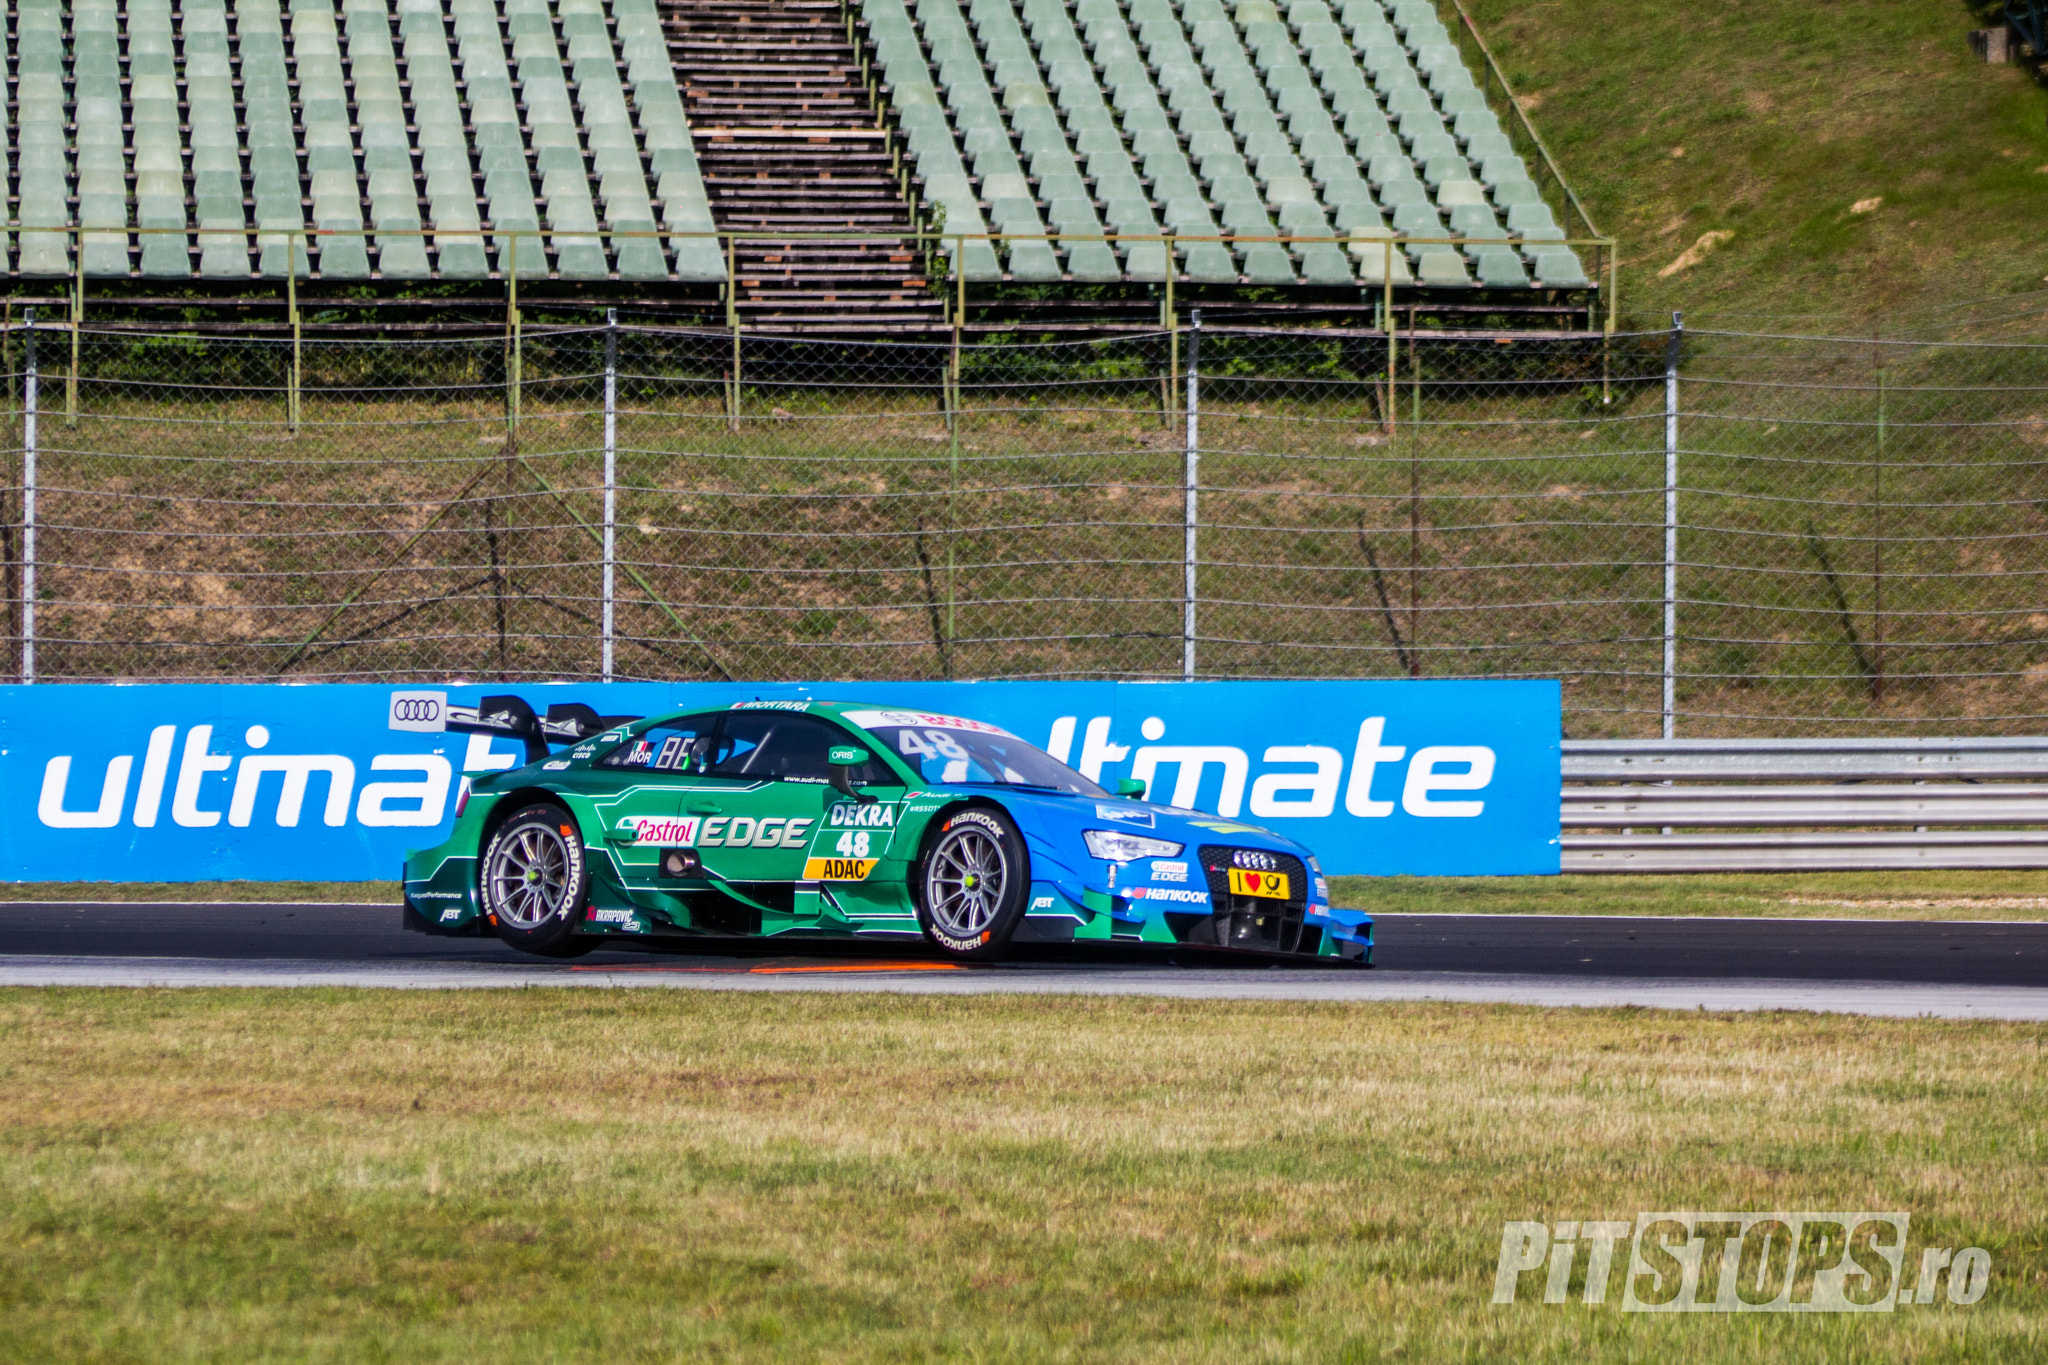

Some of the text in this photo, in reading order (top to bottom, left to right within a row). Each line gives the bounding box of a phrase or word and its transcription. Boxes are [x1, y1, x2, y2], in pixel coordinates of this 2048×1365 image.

[743, 701, 810, 712] MORTARA
[628, 752, 652, 763] MOR
[831, 752, 853, 760] ORIS
[1046, 716, 1496, 818] ltimate
[38, 725, 517, 828] ultimat
[830, 804, 893, 827] DEKRA
[637, 817, 815, 849] Castrol EDGE
[836, 831, 870, 858] 48
[823, 860, 865, 879] ADAC
[1151, 872, 1188, 882] EDGE
[1030, 897, 1054, 911] ABT
[439, 909, 461, 922] ABT
